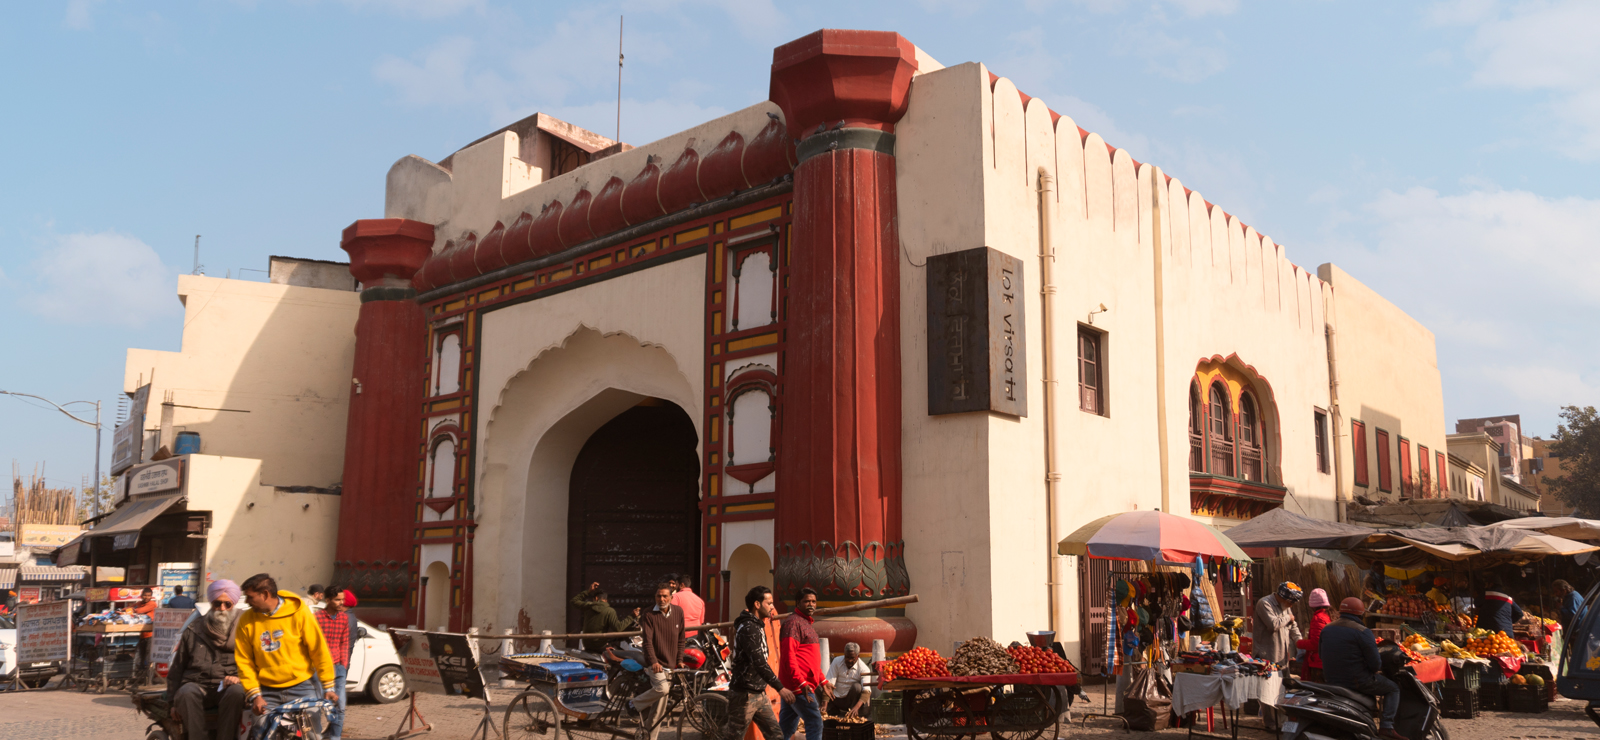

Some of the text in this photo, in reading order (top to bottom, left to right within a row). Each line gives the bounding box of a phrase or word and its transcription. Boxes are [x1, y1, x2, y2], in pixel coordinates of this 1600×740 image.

[1002, 268, 1014, 304] lok
[150, 479, 159, 487] HALAL
[160, 477, 169, 485] SHOP
[403, 656, 434, 667] PLEASE STOP
[437, 655, 466, 666] KEI
[405, 666, 415, 675] FOR
[415, 668, 440, 678] CHECKING
